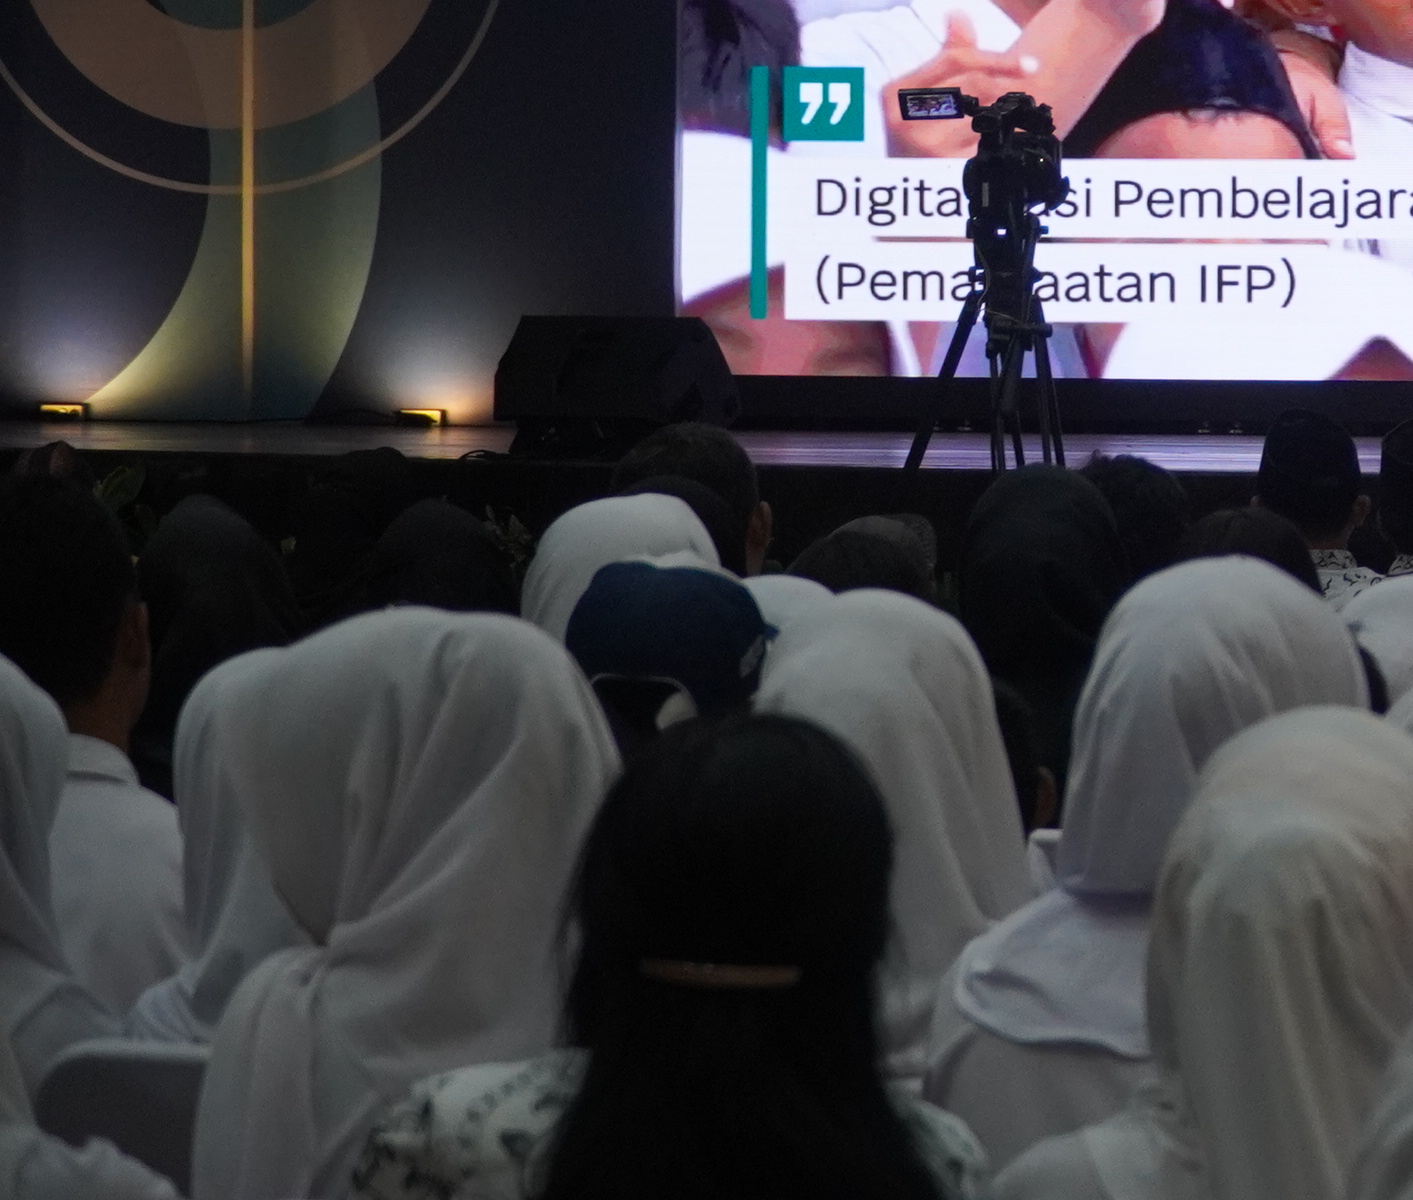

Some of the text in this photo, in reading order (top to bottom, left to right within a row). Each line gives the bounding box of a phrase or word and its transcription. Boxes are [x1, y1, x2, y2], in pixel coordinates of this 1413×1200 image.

[816, 177, 1092, 227] Digitasi
[816, 255, 1296, 308] (Pemaaatan IFP)
